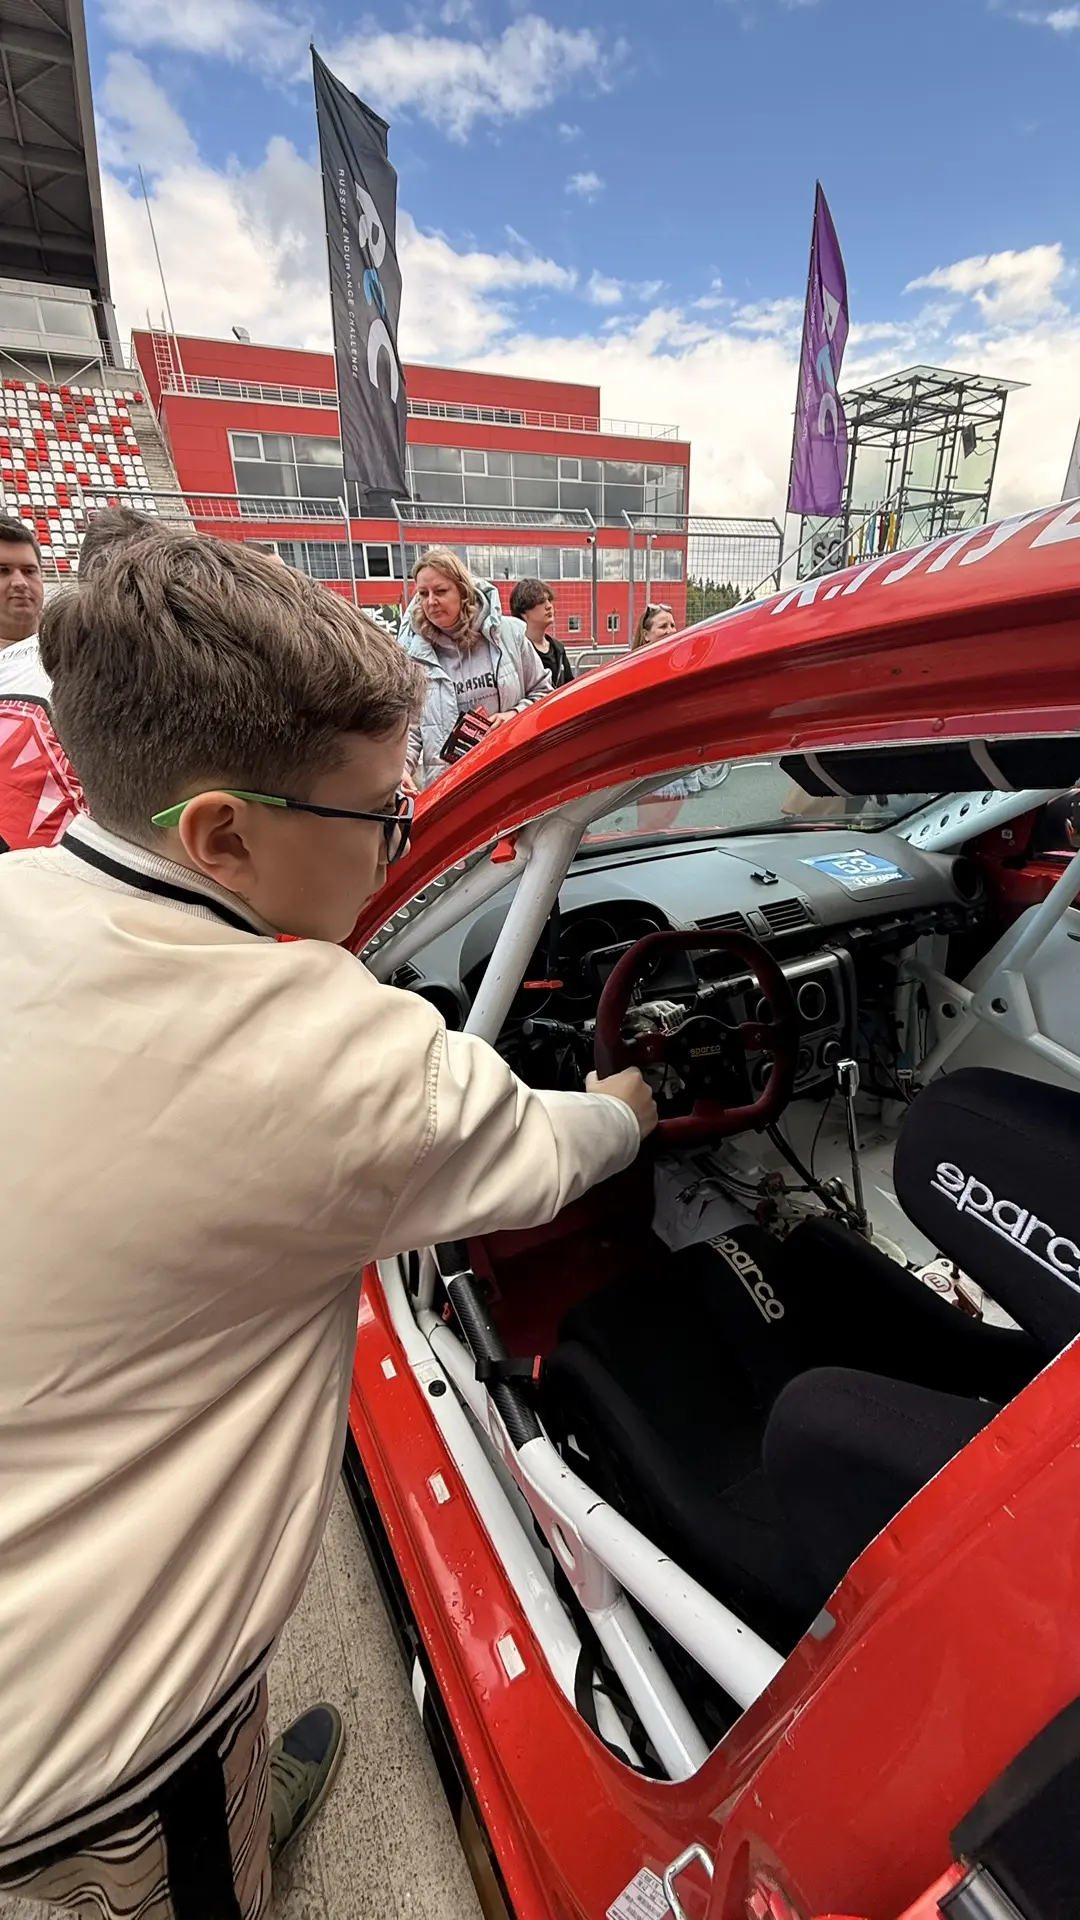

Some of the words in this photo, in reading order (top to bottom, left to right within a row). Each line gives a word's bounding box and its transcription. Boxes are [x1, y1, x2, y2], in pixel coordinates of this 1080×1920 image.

[338, 168, 348, 225] RUSSIAN
[342, 227, 355, 306] ENDURANCE
[348, 311, 358, 379] CHALLENGE
[832, 858, 877, 875] 53
[690, 1045, 721, 1057] sparco
[932, 1162, 1080, 1281] sparc
